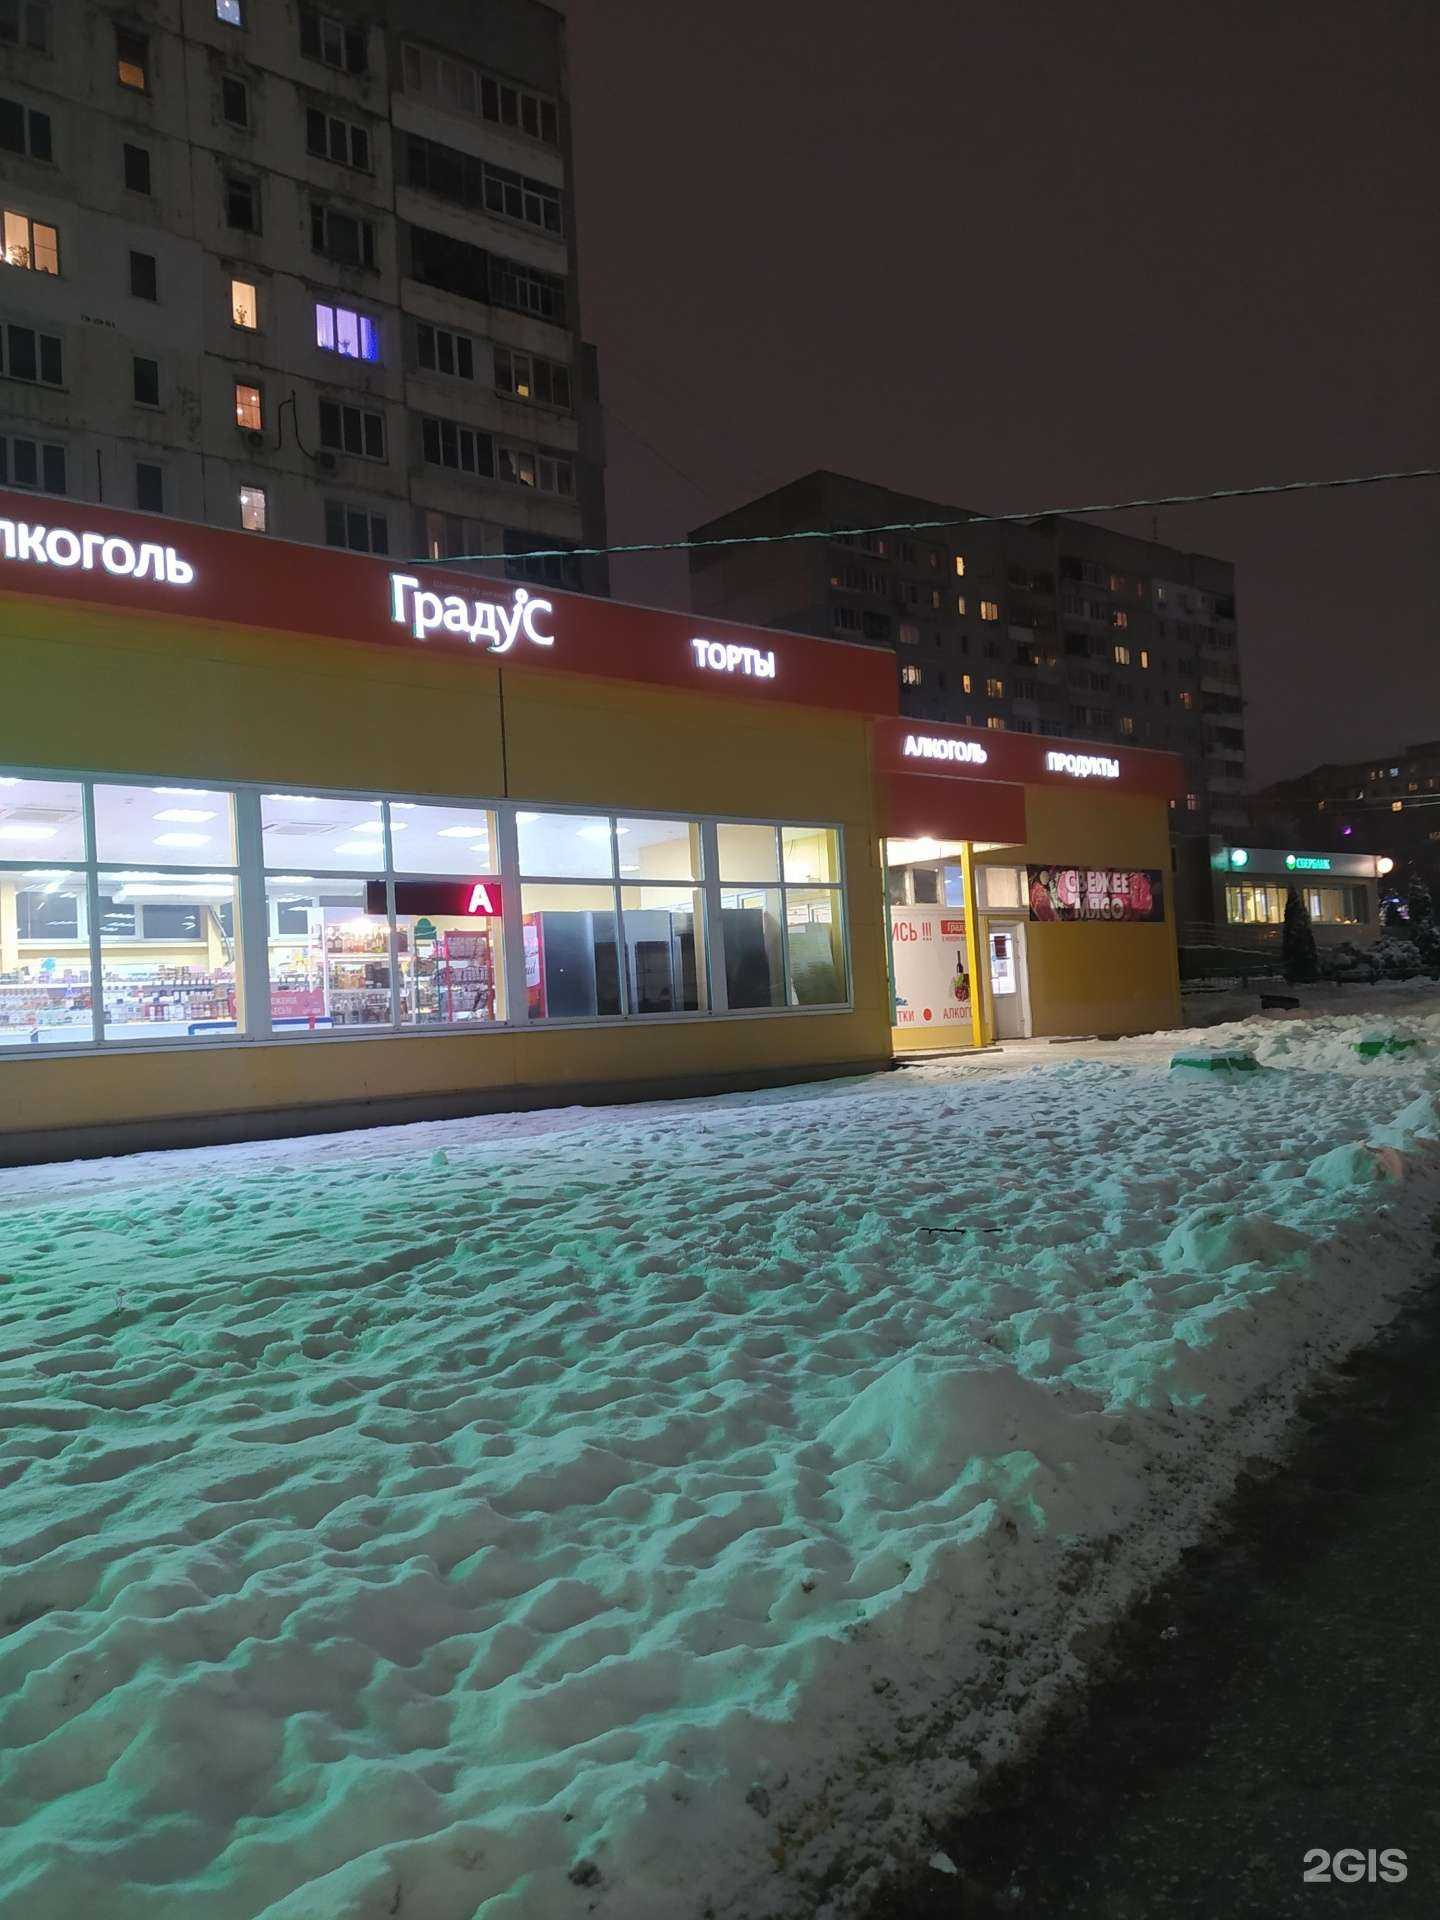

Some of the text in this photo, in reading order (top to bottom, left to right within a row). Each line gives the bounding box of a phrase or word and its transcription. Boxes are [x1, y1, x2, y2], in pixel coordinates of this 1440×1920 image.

[691, 638, 776, 678] ТОРТЫ
[904, 735, 988, 764] АЛКОГОЛЬ
[1047, 751, 1120, 778] ПРОДУКТЫ
